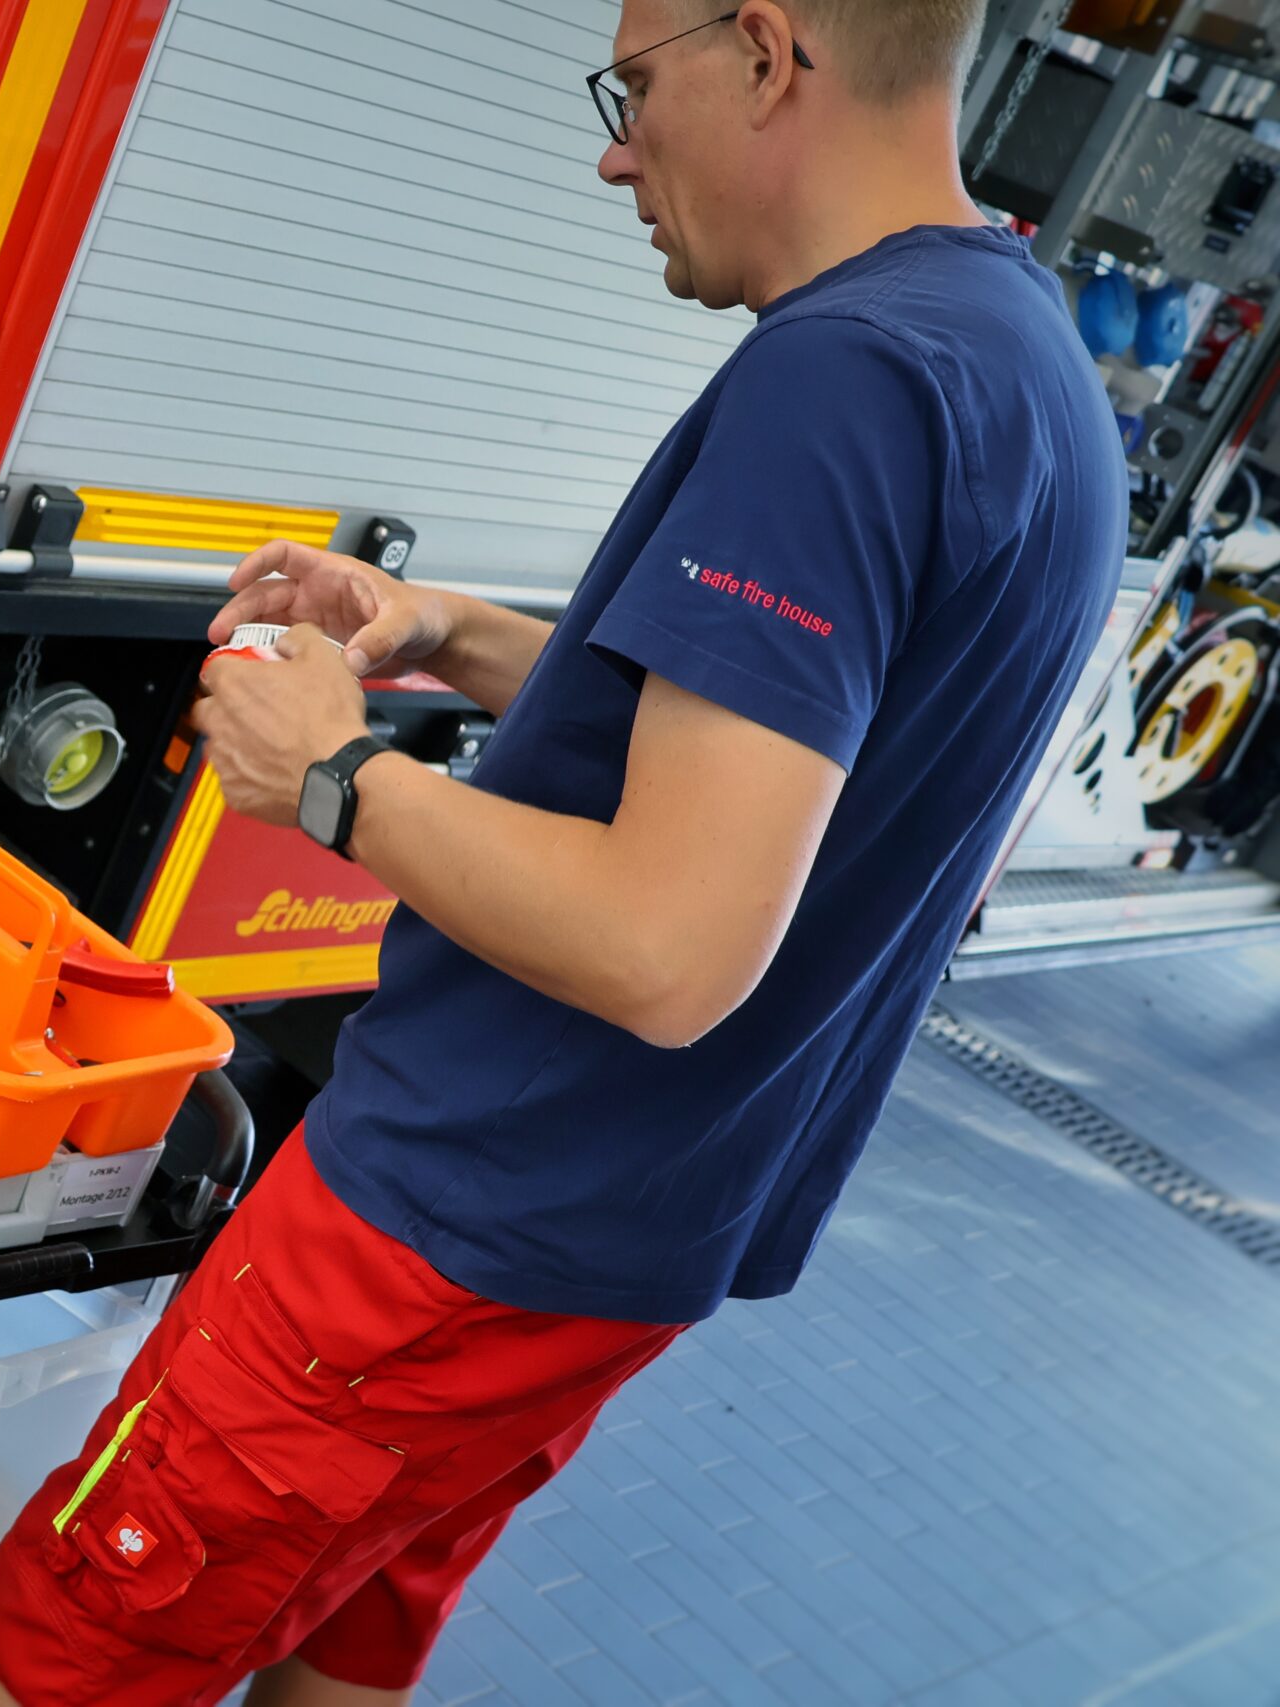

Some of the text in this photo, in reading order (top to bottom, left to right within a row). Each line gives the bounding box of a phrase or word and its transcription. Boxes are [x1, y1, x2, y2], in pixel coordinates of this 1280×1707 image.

[385, 546, 405, 563] G6
[699, 567, 834, 637] safe fire house
[59, 1186, 131, 1207] Montage 2/12
